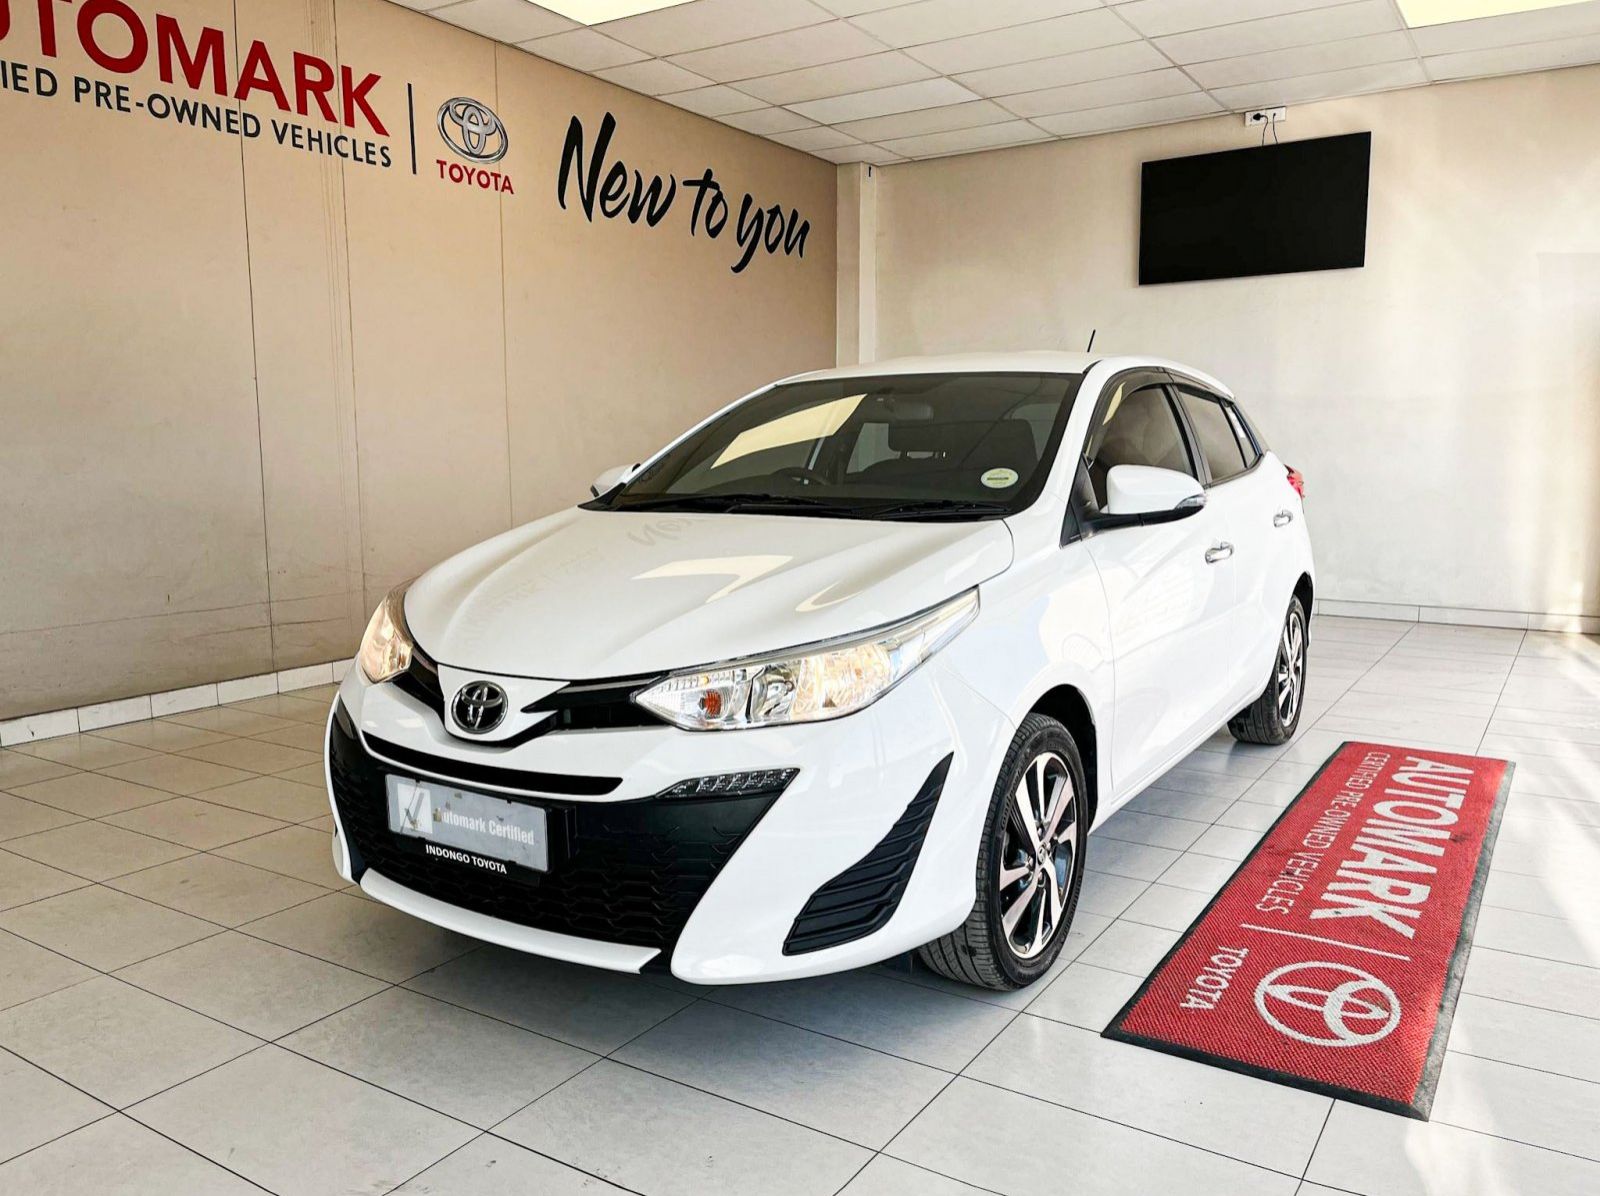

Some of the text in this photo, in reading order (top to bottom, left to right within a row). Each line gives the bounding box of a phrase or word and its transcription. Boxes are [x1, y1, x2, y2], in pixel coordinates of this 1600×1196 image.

[74, 76, 261, 138] PRE-OWNED
[271, 119, 392, 168] VEHICLES
[436, 159, 514, 195] TOYOTA
[557, 111, 811, 274] New to you
[425, 844, 508, 875] INDONGO TOYOTA
[488, 819, 535, 846] Certified
[1255, 751, 1391, 916] CERTIFIED PRE-OWNED VEHICLES
[1309, 755, 1475, 940] AUTOMARK
[1179, 945, 1250, 1011] TOYOTA
